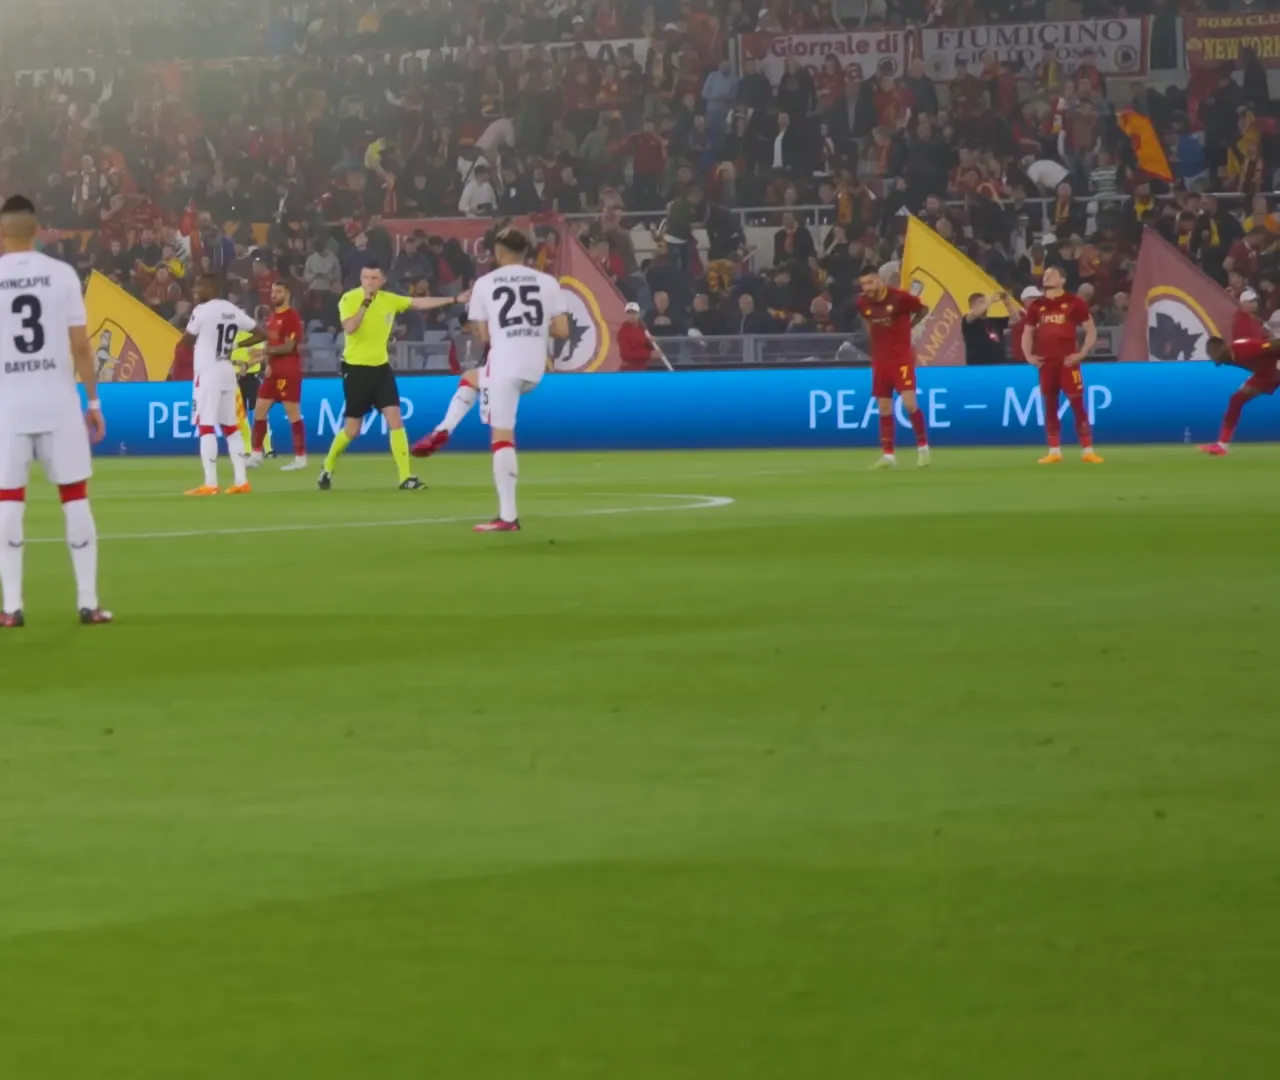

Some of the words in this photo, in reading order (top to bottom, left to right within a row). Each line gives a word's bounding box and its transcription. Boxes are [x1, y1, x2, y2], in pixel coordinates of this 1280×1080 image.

[770, 35, 870, 58] Giornale
[875, 33, 899, 54] di
[936, 19, 1128, 51] FIUMICINO
[492, 284, 544, 329] 25
[11, 293, 45, 355] 3
[216, 322, 239, 356] 19
[4, 358, 41, 375] BAYER
